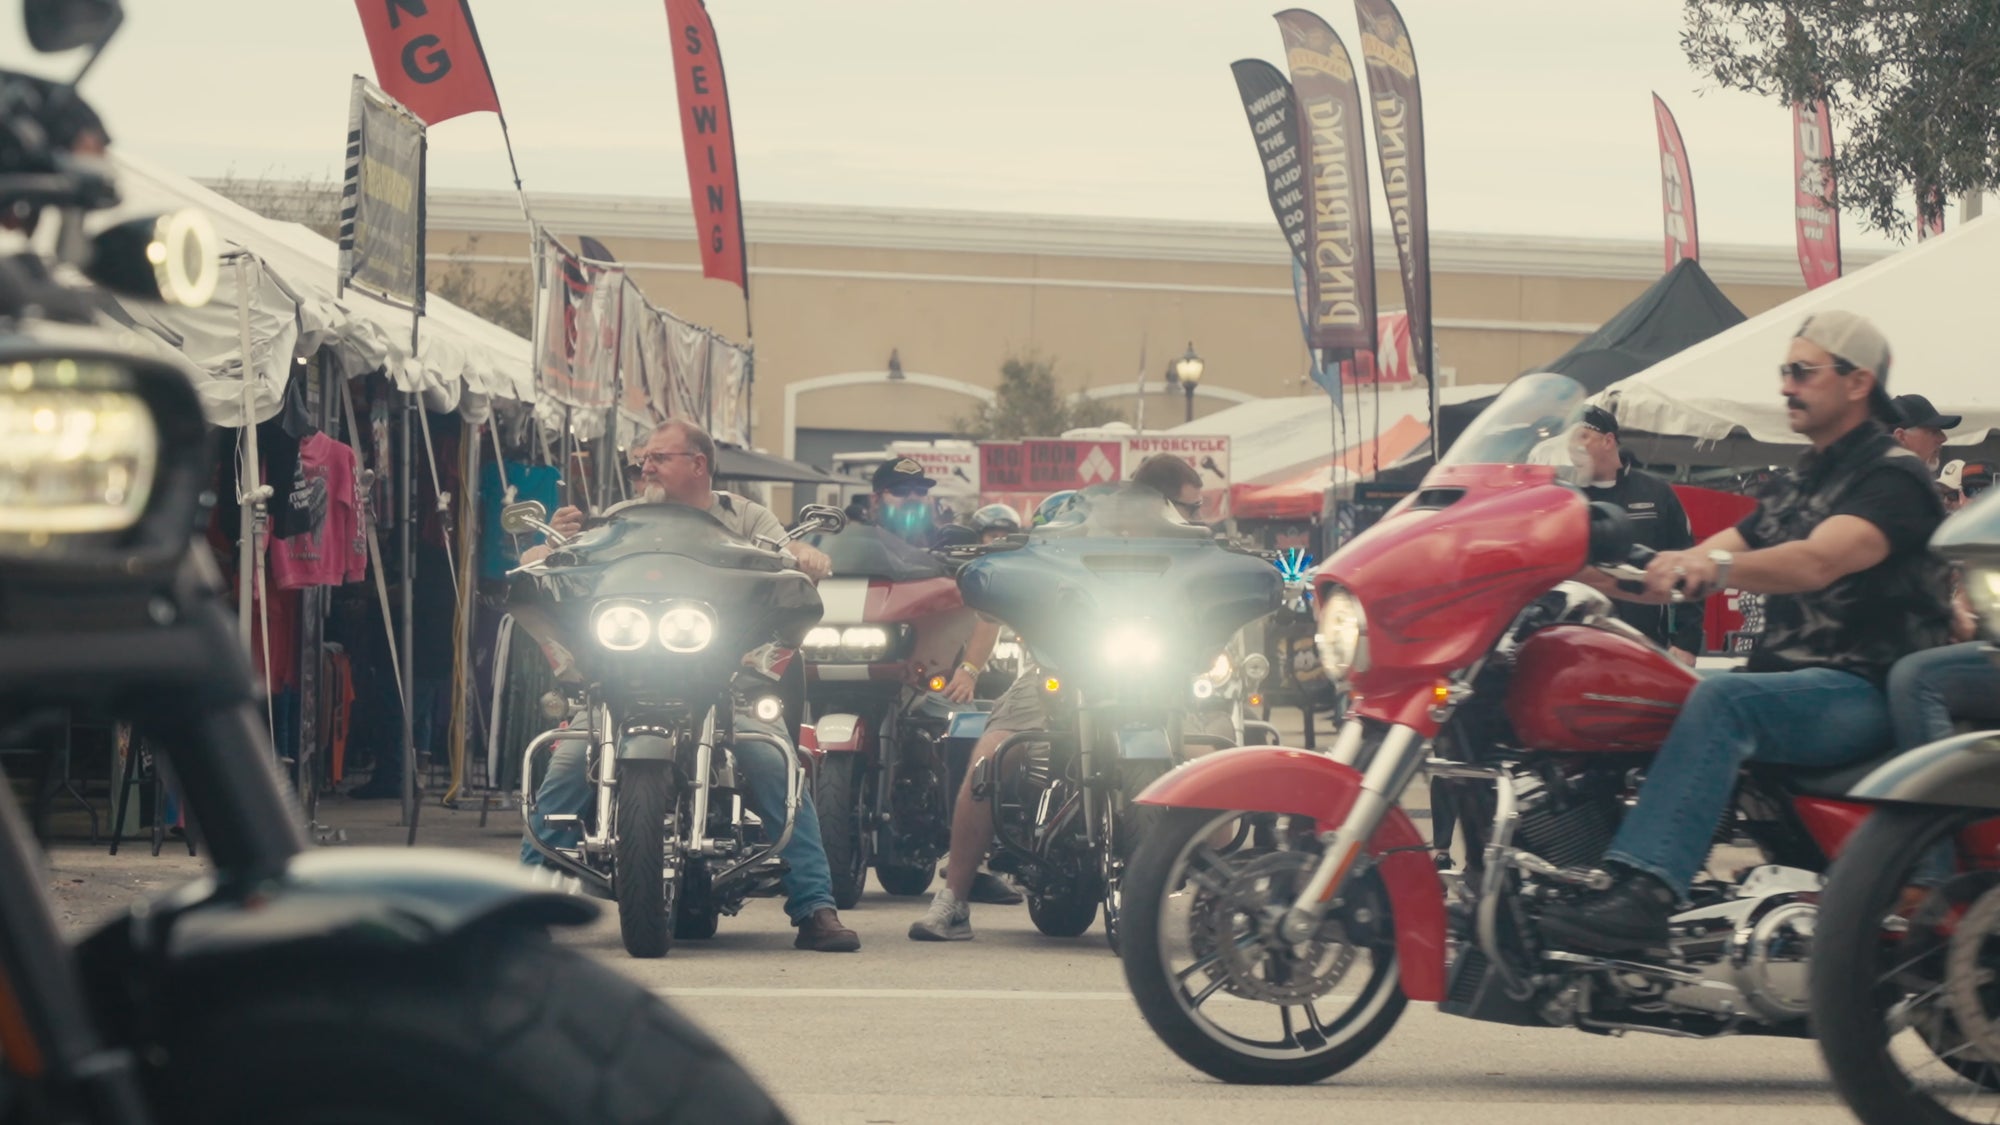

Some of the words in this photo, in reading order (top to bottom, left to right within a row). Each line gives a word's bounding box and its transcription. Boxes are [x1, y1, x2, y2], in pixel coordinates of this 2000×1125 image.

[1249, 86, 1287, 116] WHEN
[1255, 112, 1287, 135] ONLY
[684, 25, 725, 255] SEWING
[1261, 133, 1287, 155] THE
[1267, 147, 1297, 173] BEST
[1273, 165, 1302, 193] AUD
[1277, 189, 1303, 211] WIL
[1284, 208, 1304, 229] DO
[1130, 438, 1225, 452] MOTORCYCLE
